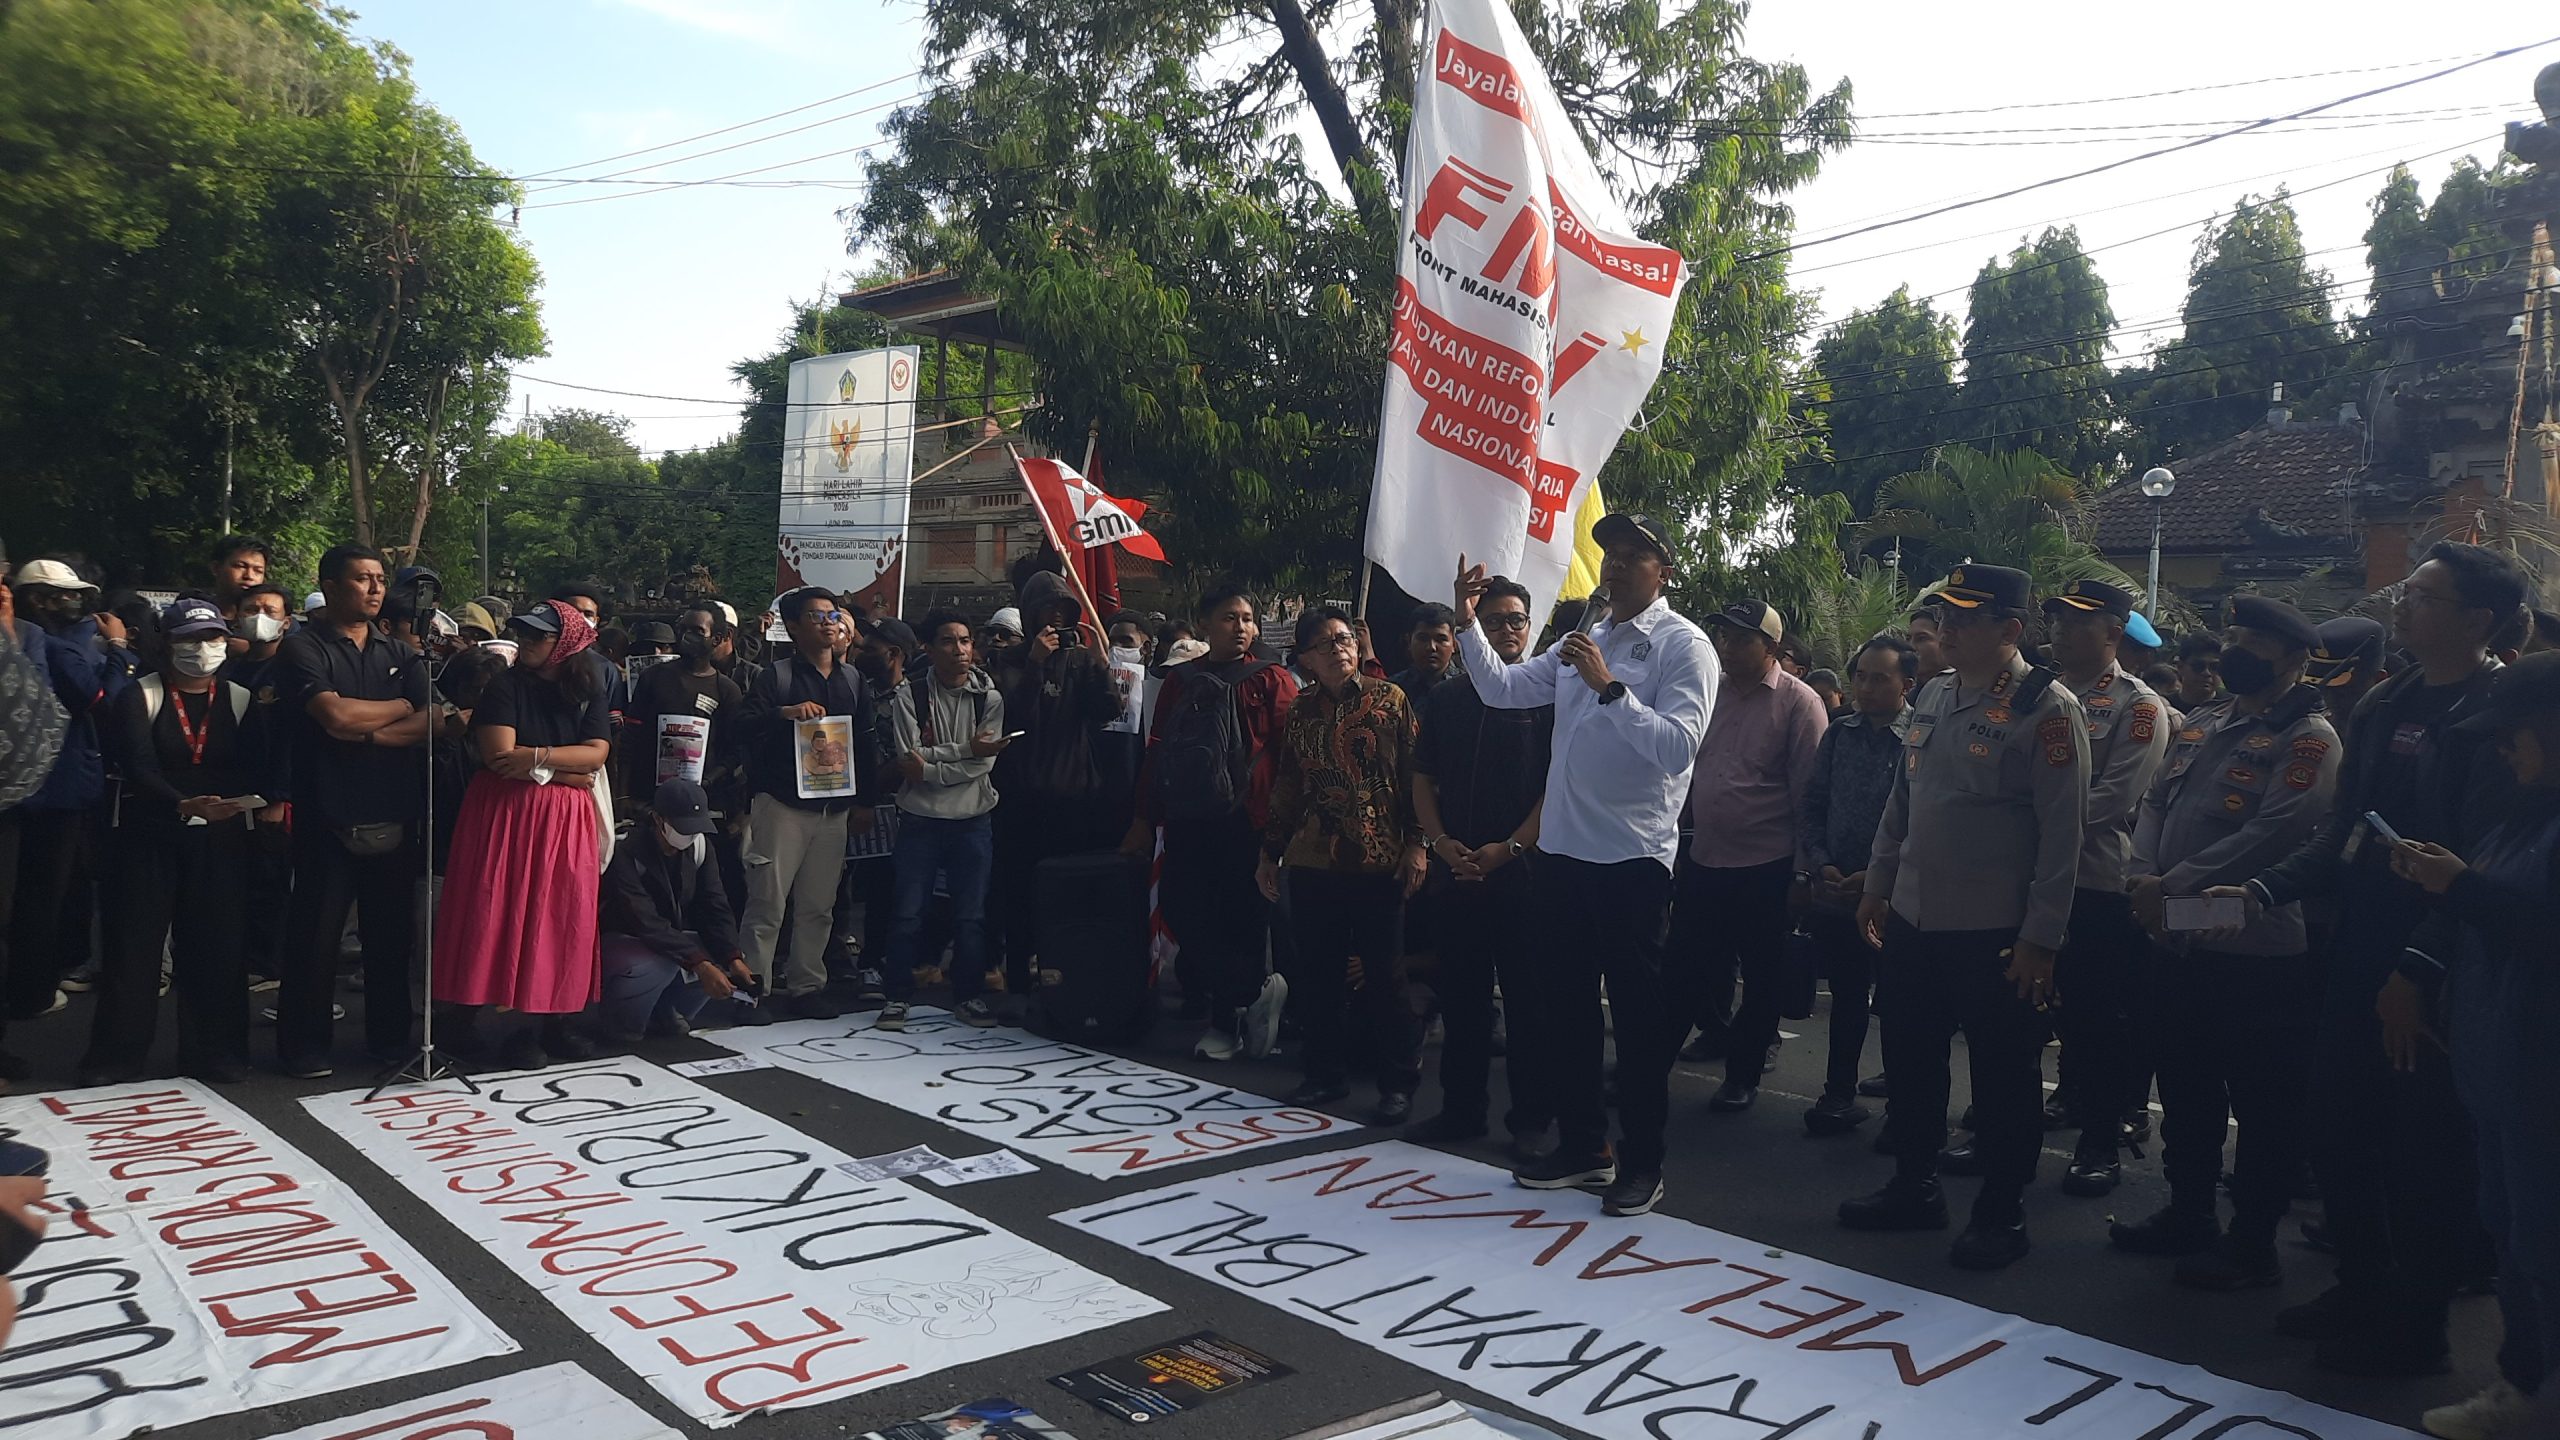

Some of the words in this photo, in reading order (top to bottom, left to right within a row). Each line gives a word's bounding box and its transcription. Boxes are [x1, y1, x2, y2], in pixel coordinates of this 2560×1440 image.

[1409, 230, 1457, 283] FRONT
[1393, 290, 1478, 369] UJUDKAN
[1423, 367, 1475, 407] DAN
[823, 480, 840, 490] HARI
[841, 478, 862, 489] LAHIR
[1968, 722, 2006, 742] POLRI
[2086, 708, 2112, 718] OLRI
[351, 1090, 536, 1162] MASIH
[1079, 1191, 1368, 1287] BALI
[442, 1152, 909, 1412] REFORMASI
[1266, 1156, 2007, 1387] MELAWAN
